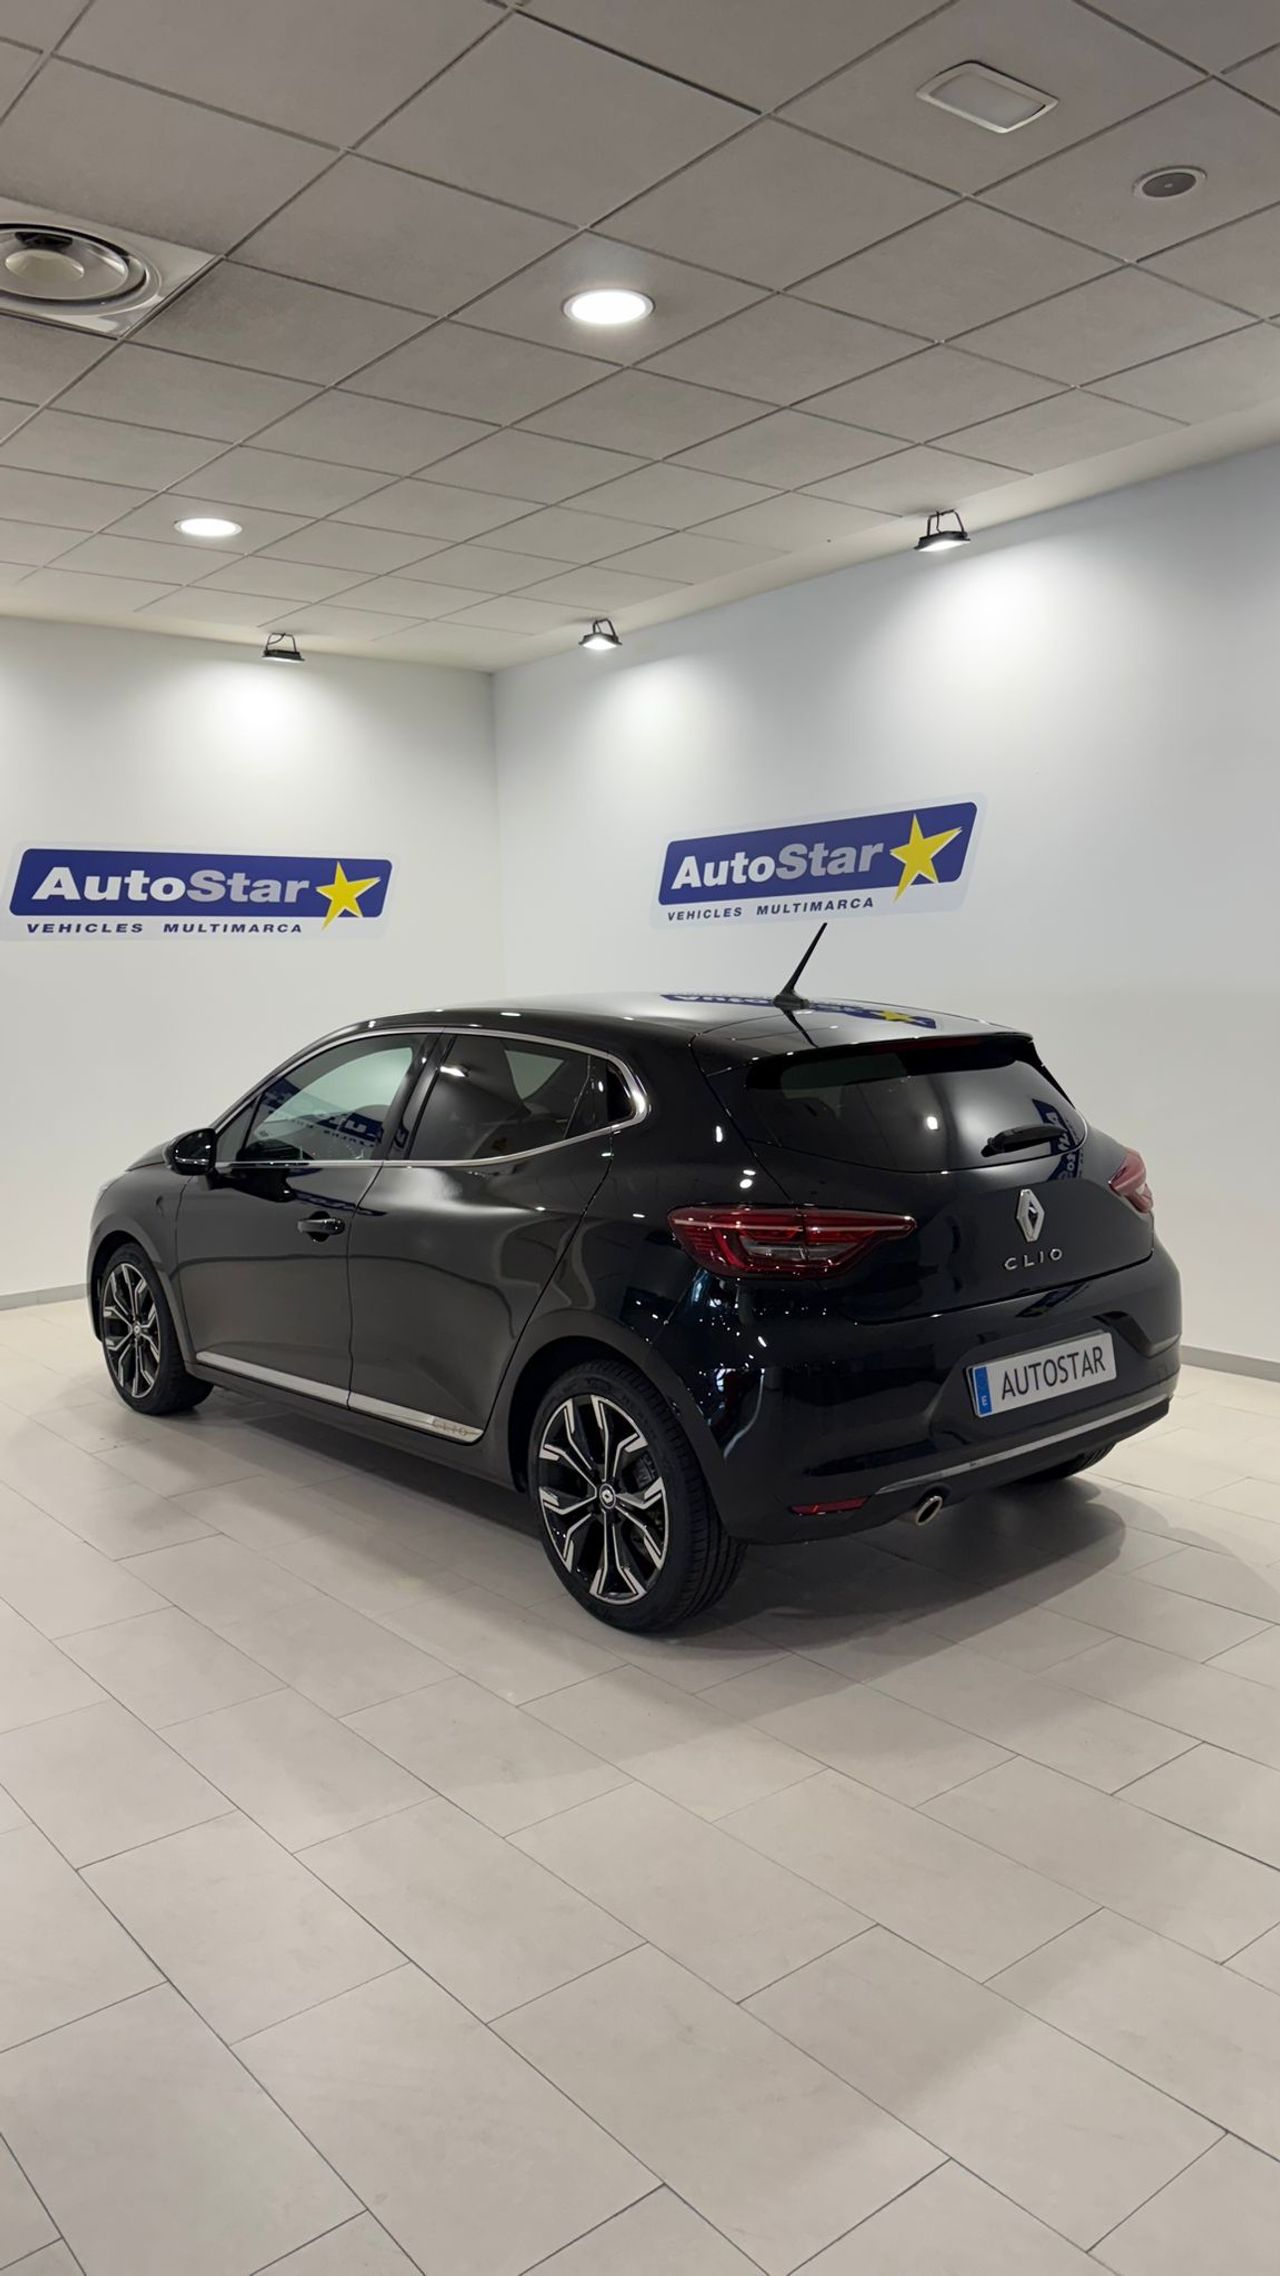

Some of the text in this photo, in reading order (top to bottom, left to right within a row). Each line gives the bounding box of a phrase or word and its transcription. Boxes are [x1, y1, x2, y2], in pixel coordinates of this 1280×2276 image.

[669, 841, 885, 890] AutoStar
[31, 866, 310, 903] AutoStar
[667, 897, 874, 921] VEHICLES MULTIMARCA
[26, 923, 302, 934] VEHICLES MULTIMARCA
[1004, 1248, 1063, 1271] CLIO
[1001, 1346, 1106, 1400] AUTOSTAR
